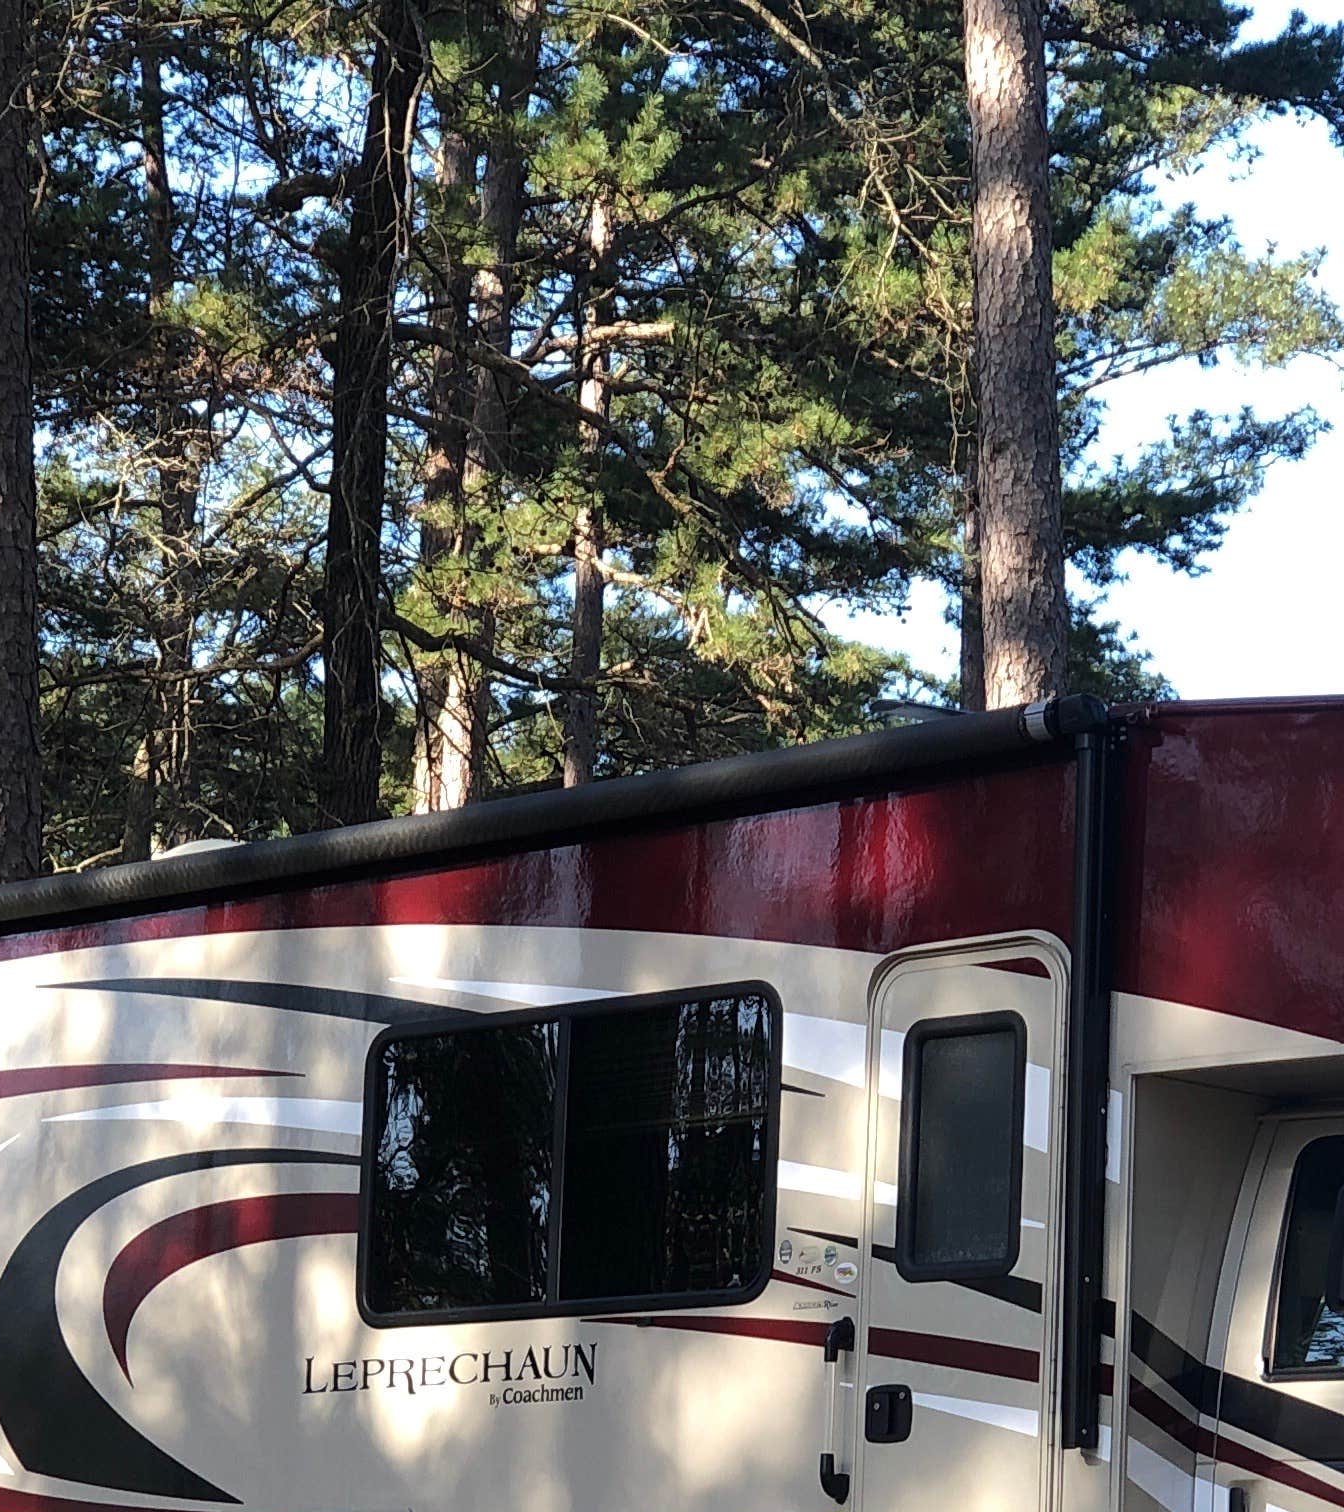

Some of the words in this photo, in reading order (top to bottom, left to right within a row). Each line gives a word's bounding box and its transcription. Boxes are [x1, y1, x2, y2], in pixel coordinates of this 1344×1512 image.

[302, 1342, 598, 1395] LEPRECHAUN
[489, 1393, 500, 1408] By
[503, 1384, 584, 1406] Coachmen
